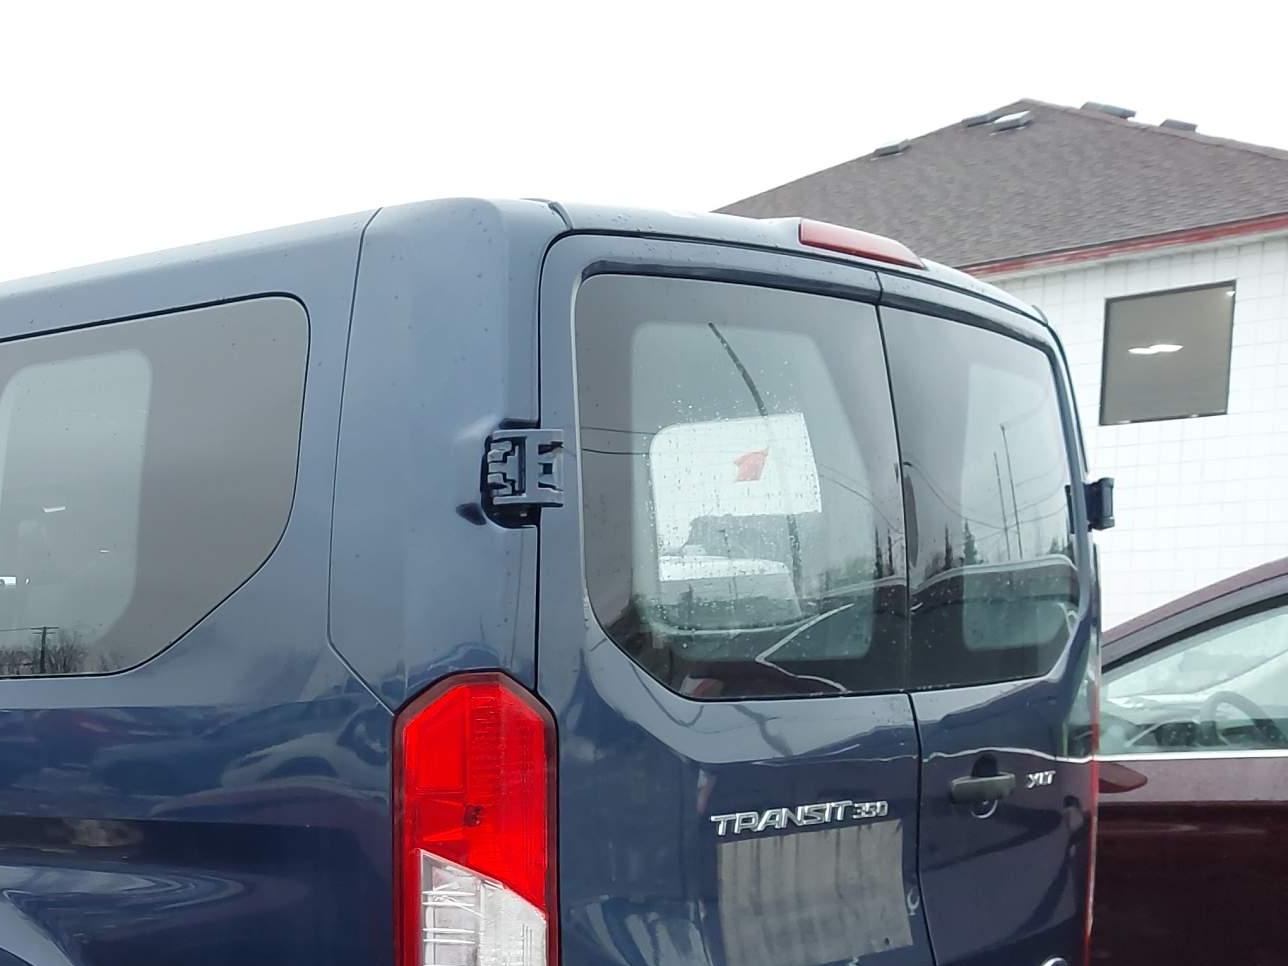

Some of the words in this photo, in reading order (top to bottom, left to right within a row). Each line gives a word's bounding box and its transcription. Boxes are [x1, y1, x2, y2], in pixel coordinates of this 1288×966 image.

[1026, 769, 1057, 789] XLT
[710, 799, 854, 837] TRANSIT
[852, 800, 889, 819] 350
